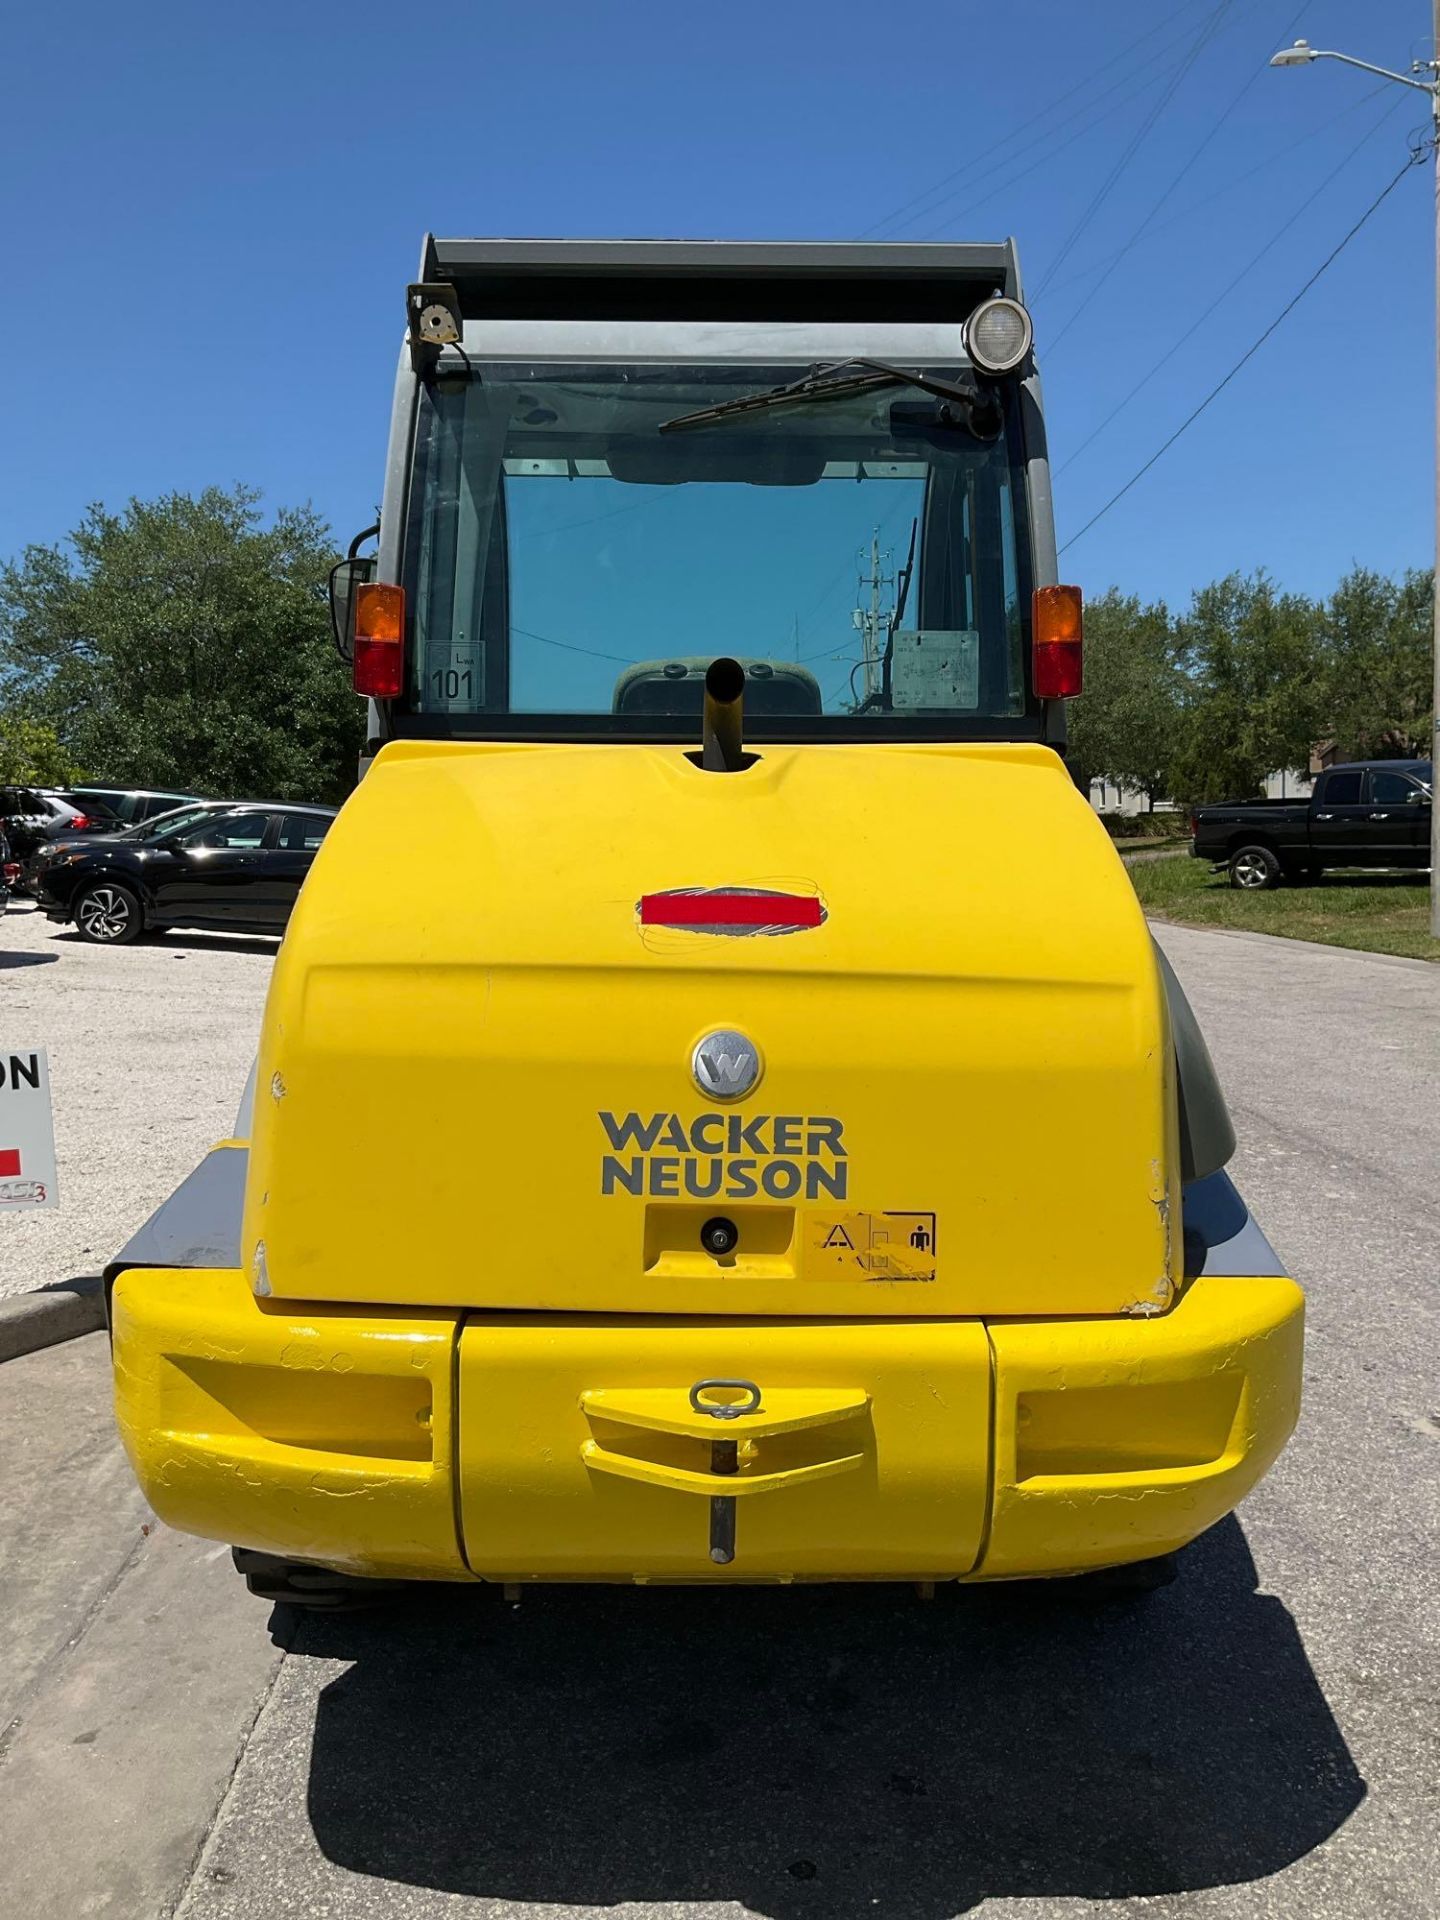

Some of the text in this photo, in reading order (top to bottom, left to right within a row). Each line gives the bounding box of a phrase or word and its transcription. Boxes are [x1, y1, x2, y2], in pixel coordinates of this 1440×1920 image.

[431, 669, 472, 699] 101
[700, 1053, 750, 1082] W
[598, 1111, 848, 1156] WACKER
[602, 1155, 847, 1200] NEUSON
